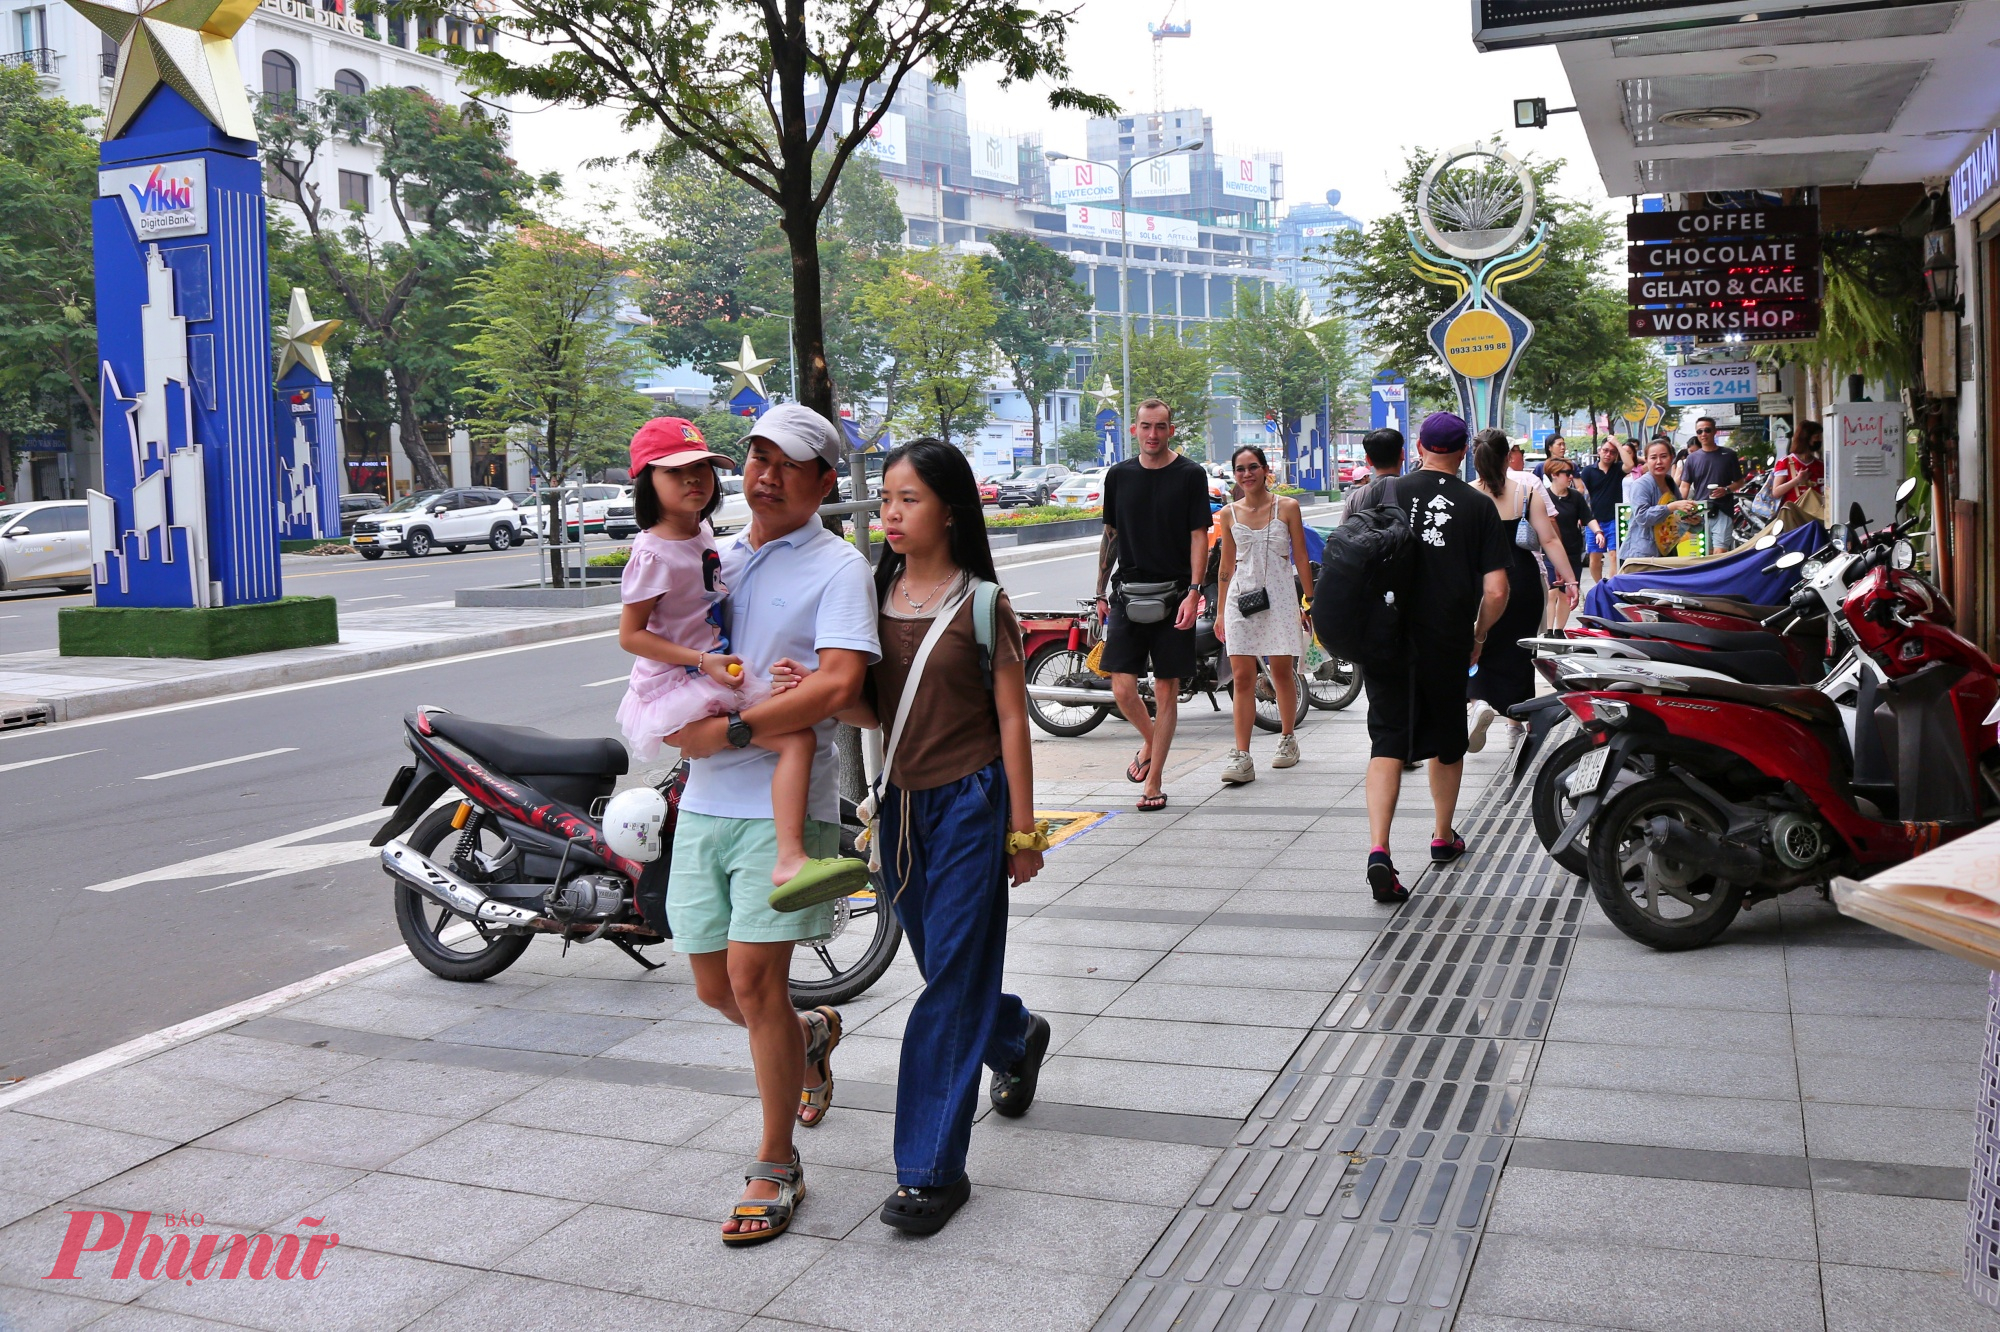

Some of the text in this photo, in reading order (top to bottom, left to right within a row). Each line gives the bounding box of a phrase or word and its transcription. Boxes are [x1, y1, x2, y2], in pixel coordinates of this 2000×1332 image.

[1950, 128, 1998, 219] VIETNAM
[128, 164, 194, 214] Vikki
[1054, 186, 1114, 199] NEWTECONS
[1225, 181, 1268, 195] NEWTECONS
[1678, 212, 1766, 232] COFFEE
[1100, 227, 1133, 238] NEWTECNS
[1649, 243, 1797, 266] CHOCOLATE
[1642, 276, 1804, 298] GELATO & CAKE
[1652, 309, 1795, 331] WORKSHOP
[1673, 368, 1700, 379] GS25
[1709, 366, 1750, 377] CAFE25
[1674, 380, 1751, 397] STORE 24H
